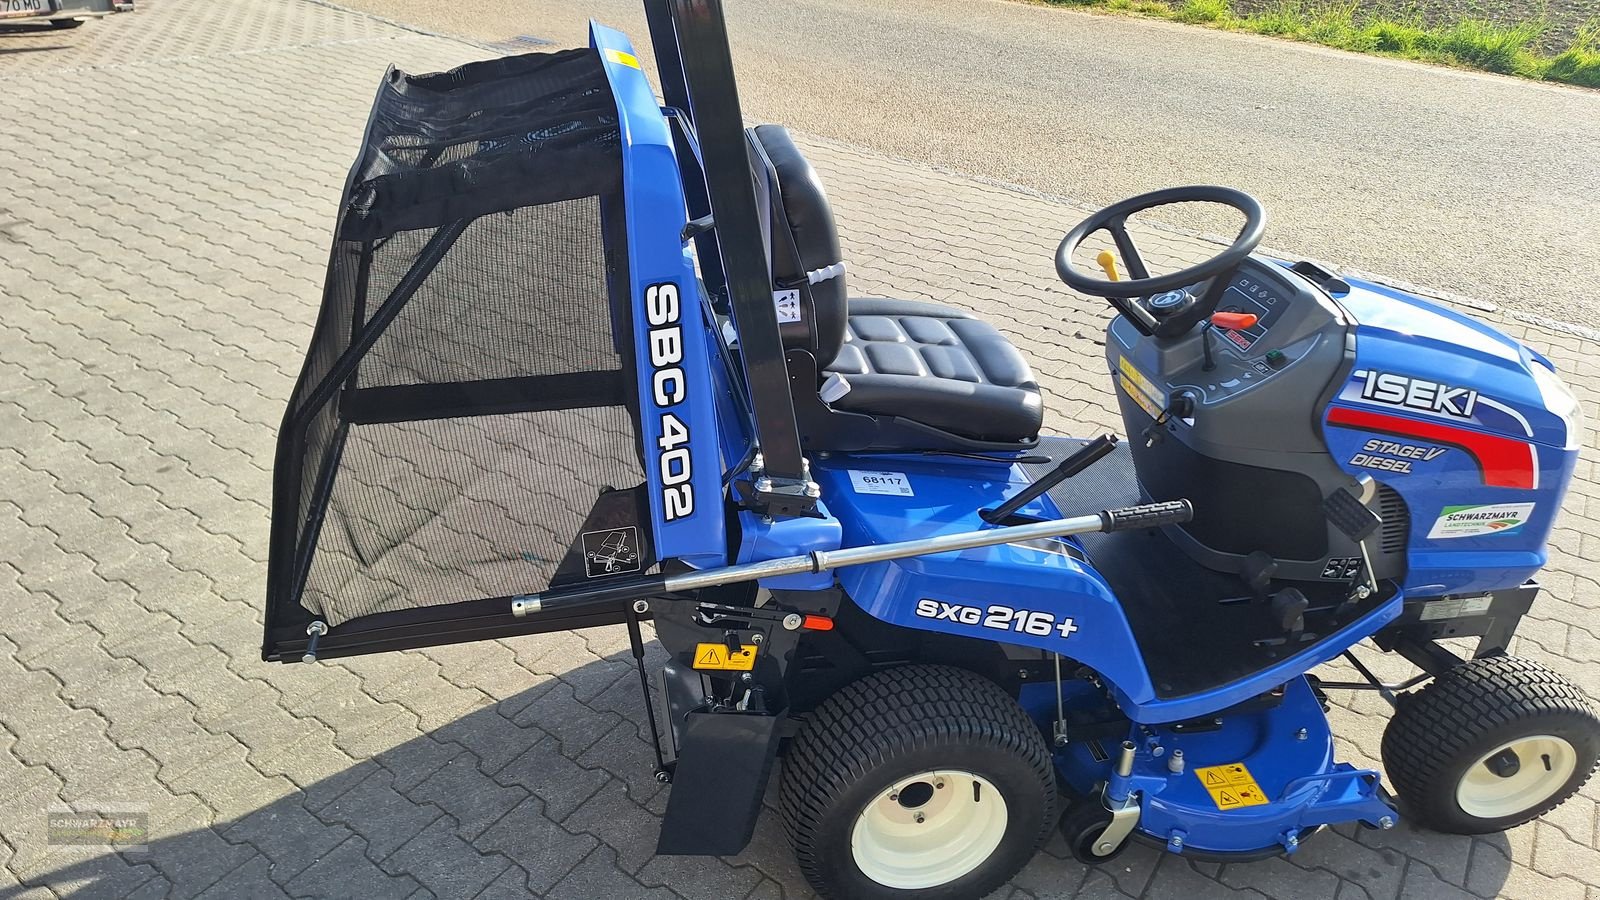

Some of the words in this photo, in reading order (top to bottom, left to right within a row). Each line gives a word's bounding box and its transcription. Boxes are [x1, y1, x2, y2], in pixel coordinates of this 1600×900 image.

[646, 284, 685, 406] SBC
[1362, 370, 1478, 417] ISEKI
[1363, 439, 1426, 459] STAGE
[659, 414, 693, 521] 402
[1349, 453, 1412, 473] DIESEL
[862, 476, 901, 485] 68117
[1446, 511, 1518, 521] SCHWARZMAYR
[916, 599, 982, 625] SXG
